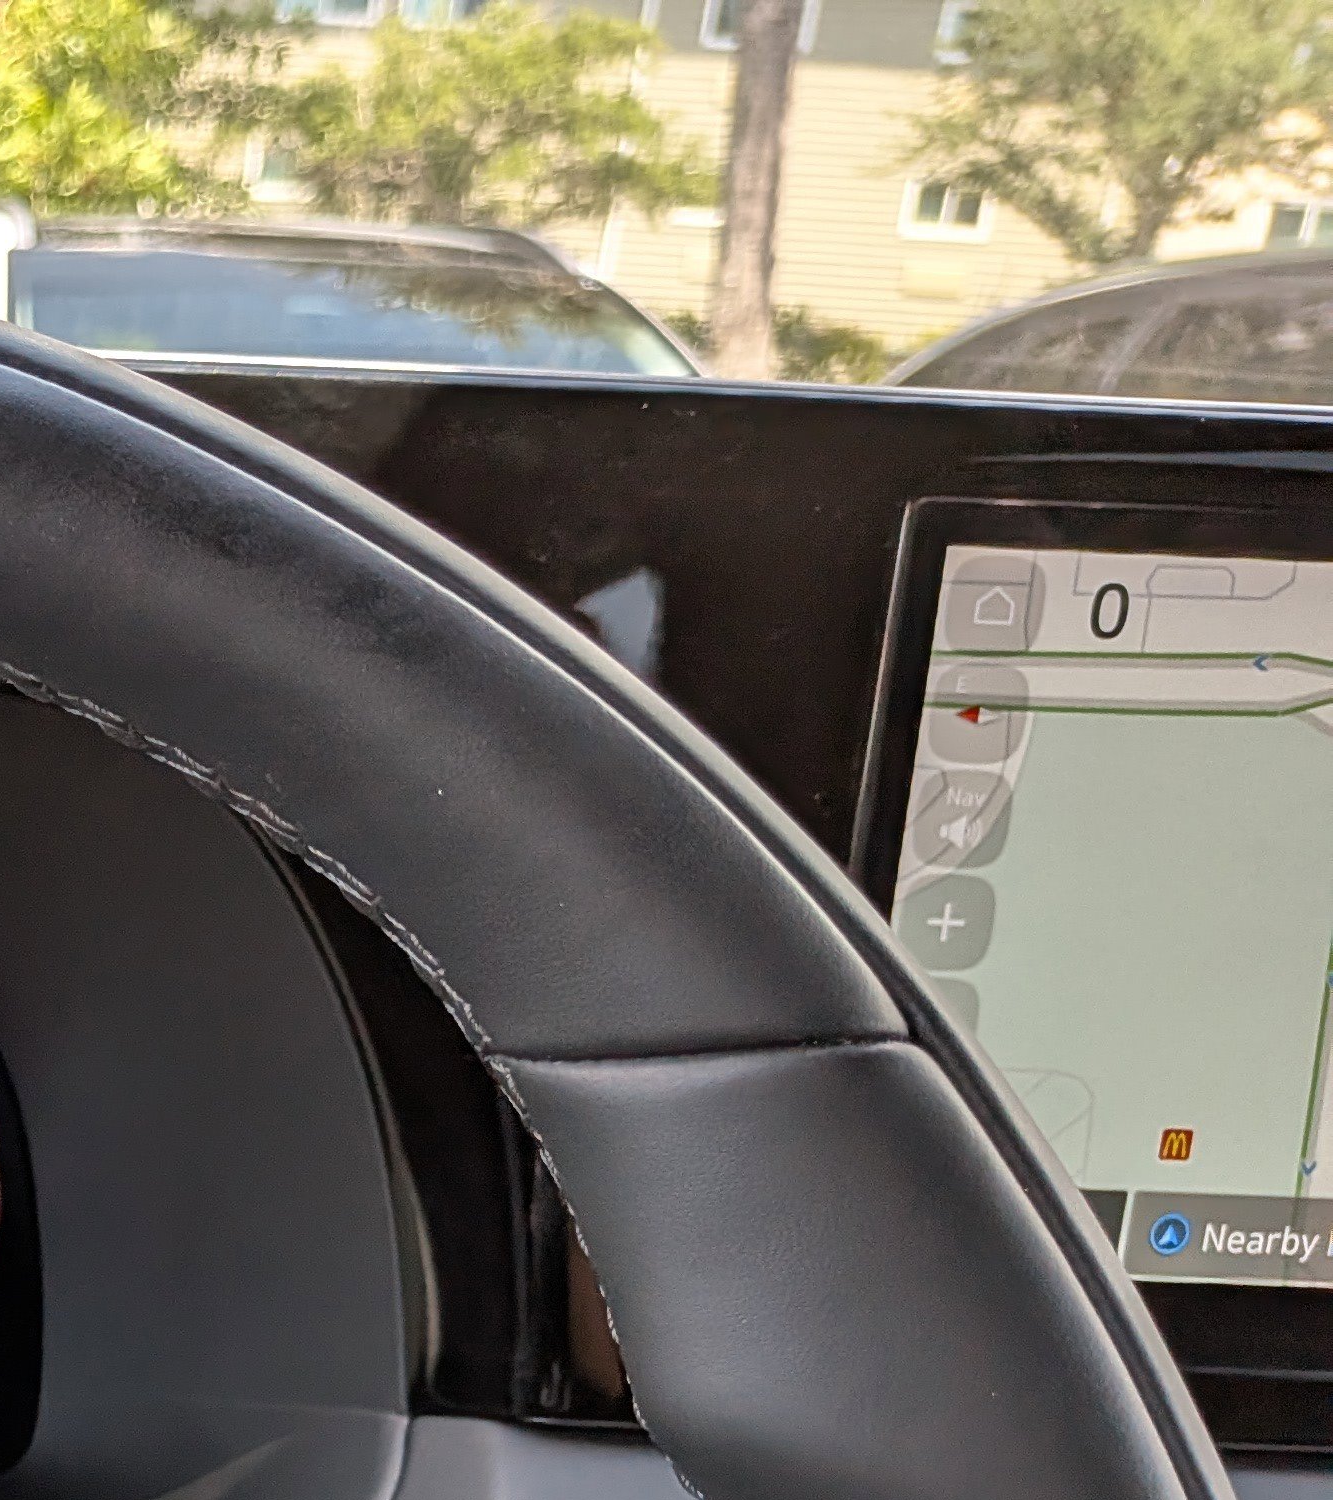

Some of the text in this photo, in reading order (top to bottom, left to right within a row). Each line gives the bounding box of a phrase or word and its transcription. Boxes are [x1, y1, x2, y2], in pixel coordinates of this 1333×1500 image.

[1090, 583, 1129, 638] 0
[946, 786, 985, 807] Nav
[1202, 1223, 1320, 1263] Nearby
